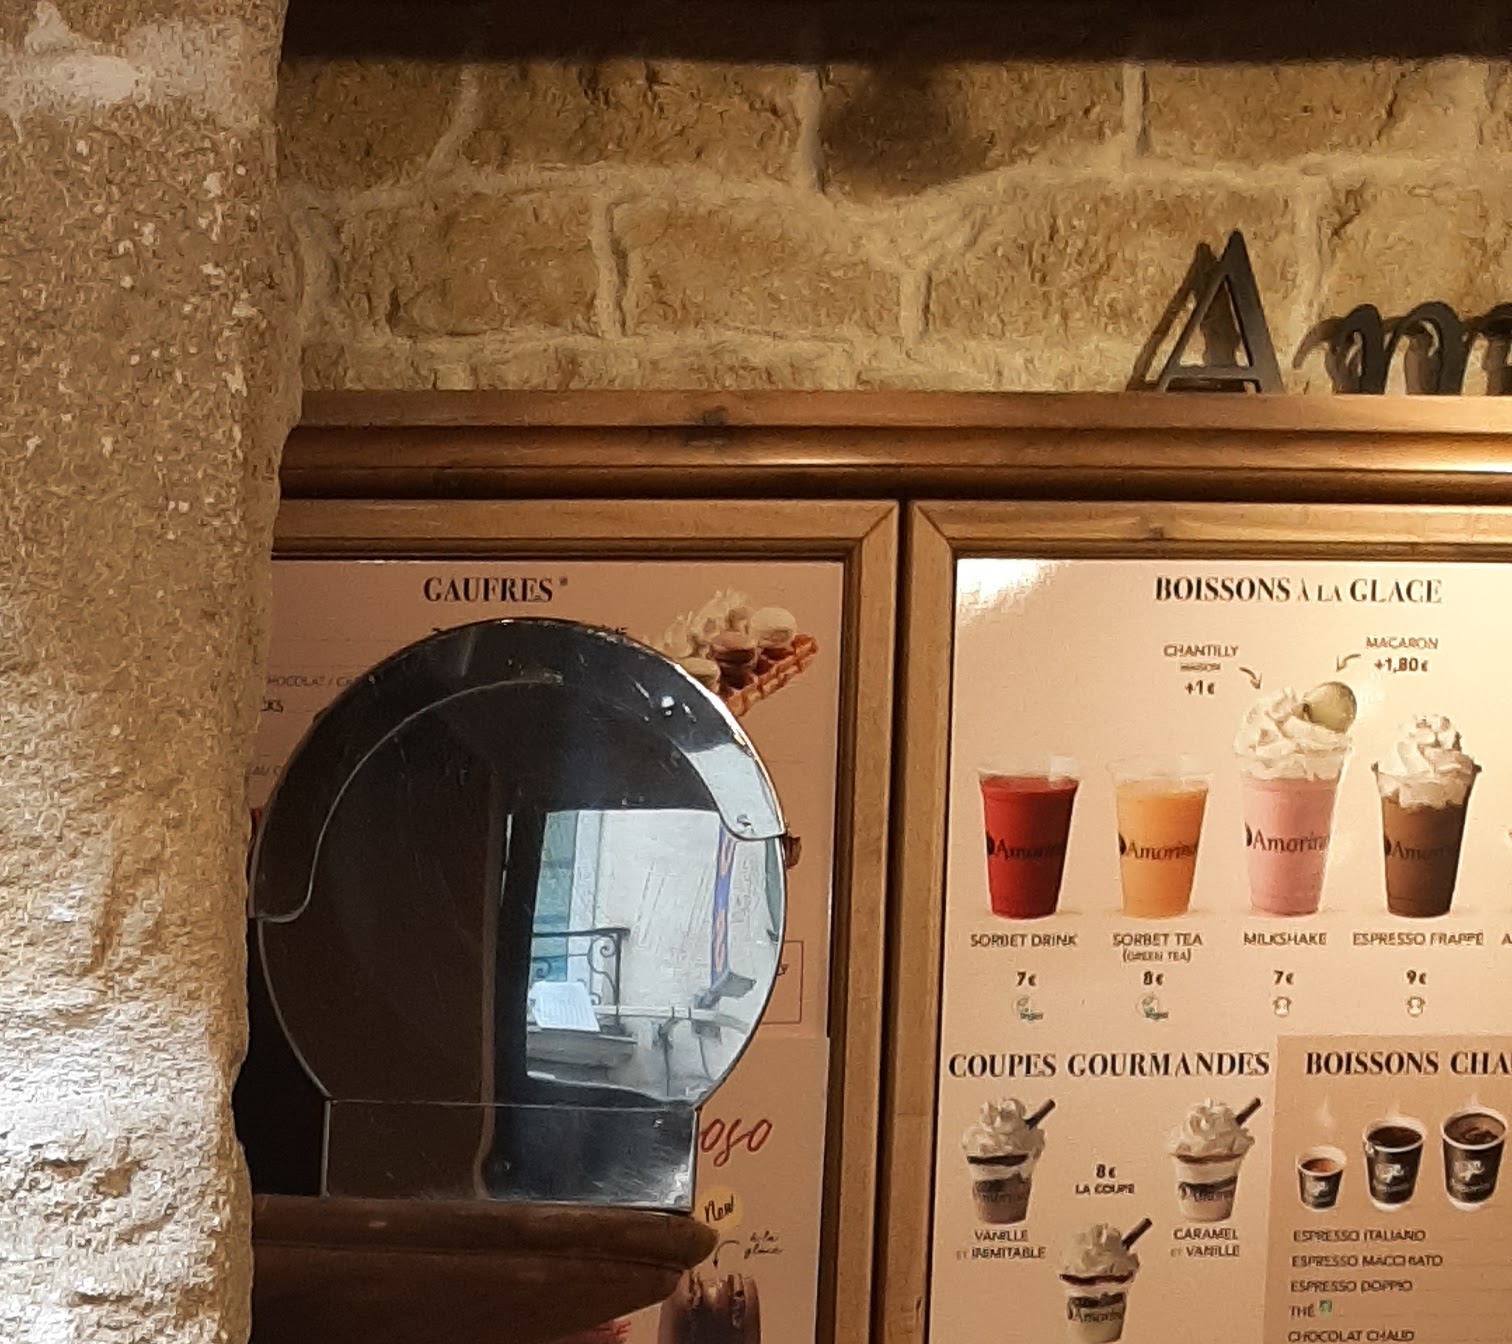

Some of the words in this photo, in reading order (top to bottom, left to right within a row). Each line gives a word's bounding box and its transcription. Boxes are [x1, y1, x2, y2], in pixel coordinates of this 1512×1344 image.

[1155, 576, 1290, 601] BOISSONS
[1317, 584, 1342, 602] LA
[1349, 578, 1442, 603] GLACE
[1366, 637, 1438, 650] MACARON
[1163, 645, 1239, 657] CHANTILLY
[970, 933, 1028, 947] SORBET
[1031, 933, 1078, 947] DRINK
[1113, 933, 1169, 947] SORBET
[1175, 933, 1202, 946] TEA
[1243, 932, 1327, 945] MILKSHAKE
[1352, 932, 1425, 945] ESPRESSO
[948, 1053, 1057, 1078] COUPES
[1068, 1052, 1270, 1078] GOURMANDES
[1305, 1051, 1439, 1076] BOISSONS
[1075, 1184, 1090, 1195] LA
[1094, 1183, 1134, 1194] COUPE
[974, 1229, 1028, 1242] VANILLE
[1173, 1228, 1238, 1241] CARAMEL
[1293, 1230, 1359, 1242] ESPRESSO
[1186, 1245, 1240, 1257] VANILLE
[1292, 1255, 1358, 1267] ESPRESSO
[1291, 1280, 1357, 1293] ESPRESSO
[1361, 1280, 1413, 1293] DOPPIO
[1289, 1303, 1315, 1317] THÉ
[1288, 1330, 1363, 1342] CHOCOLAT
[1366, 1330, 1415, 1342] CHAUD
